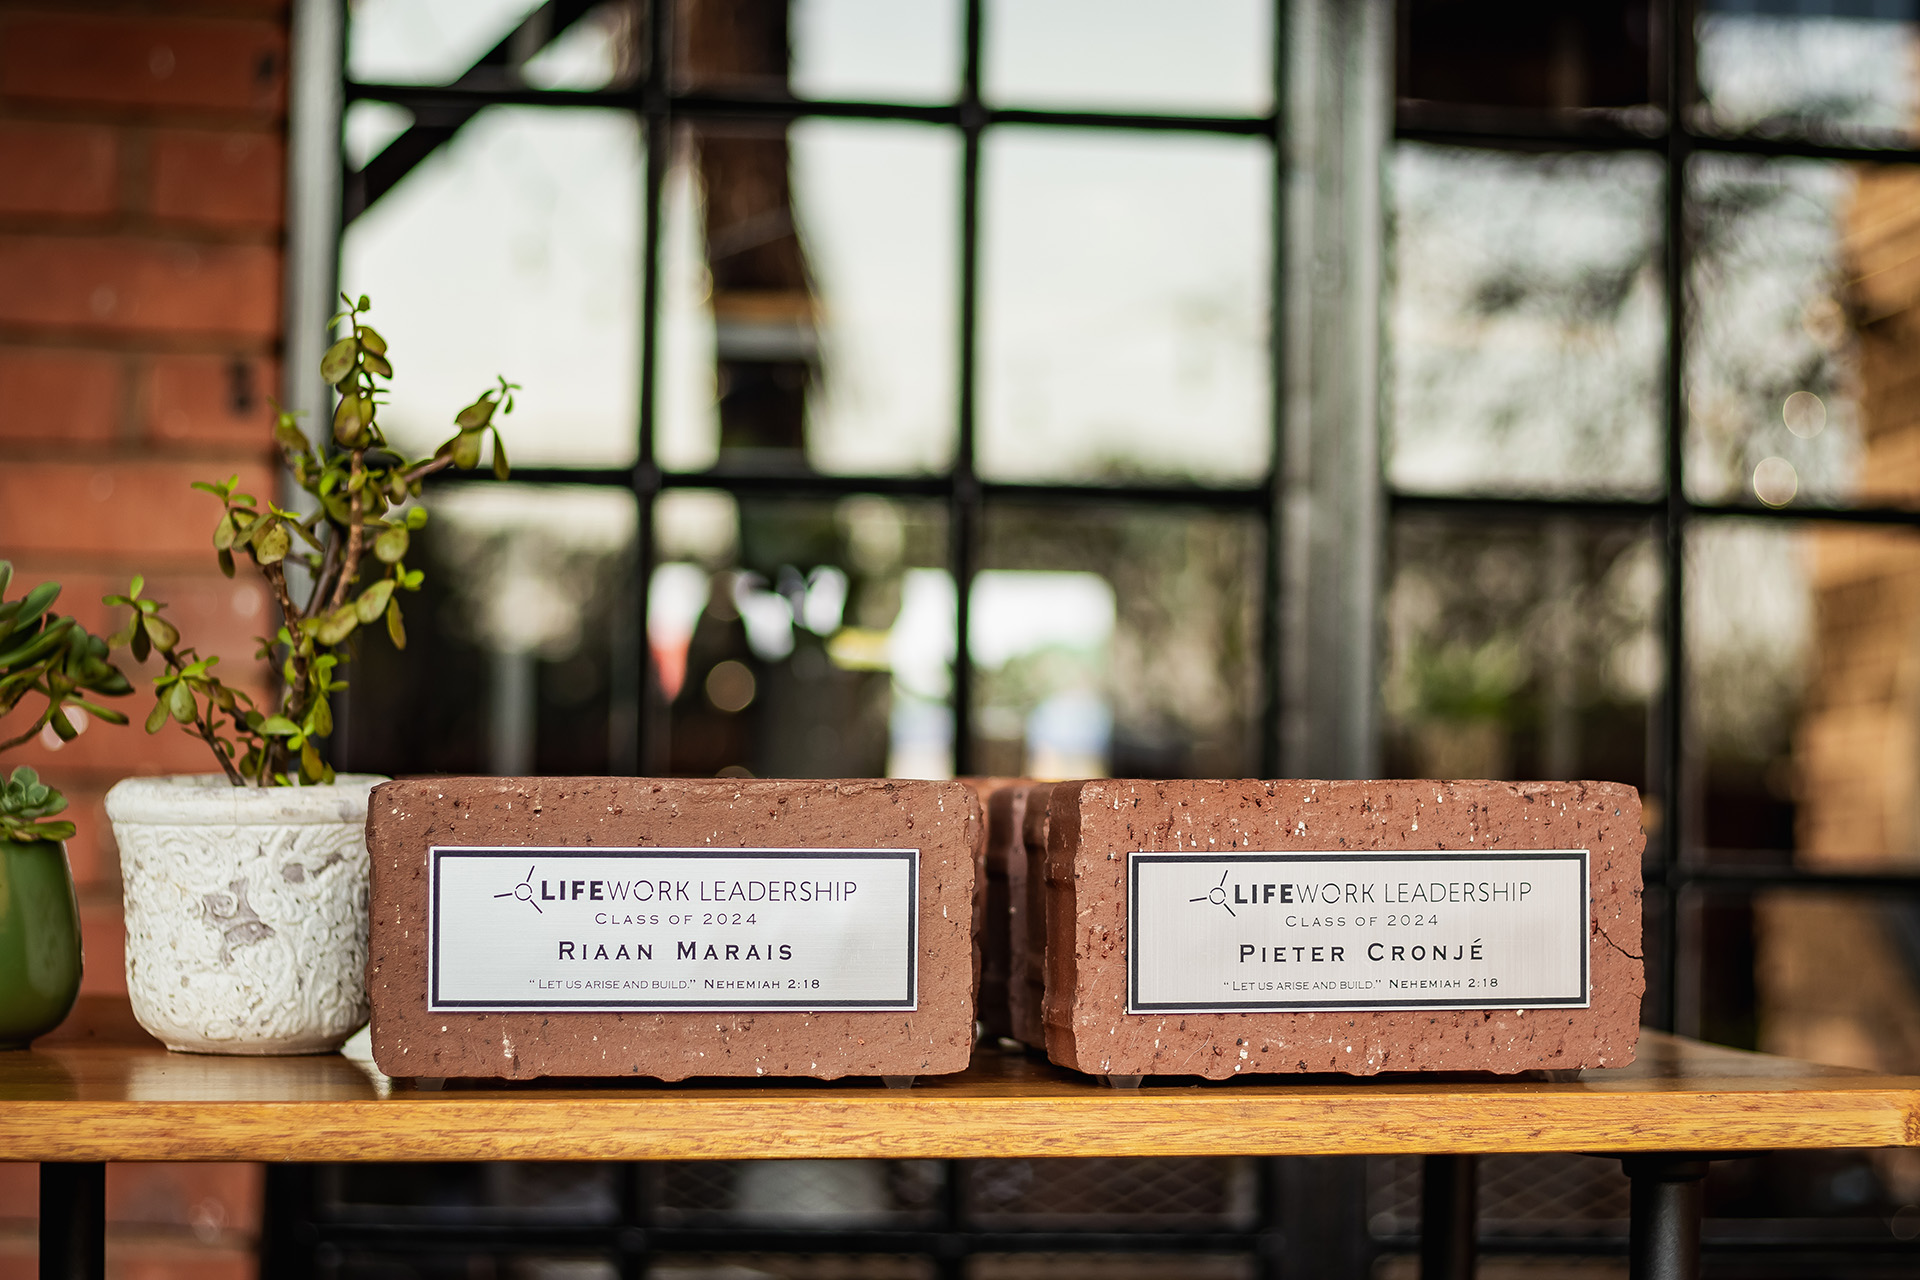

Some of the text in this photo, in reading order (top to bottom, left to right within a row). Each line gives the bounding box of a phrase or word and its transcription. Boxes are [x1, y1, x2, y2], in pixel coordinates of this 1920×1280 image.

[541, 880, 858, 902] LIFEWORK LEADERSHIP
[1234, 882, 1532, 904] LIFEWORK LEADERSHIP
[702, 912, 757, 925] 2024
[1386, 914, 1438, 927] 2024
[787, 978, 821, 990] 2:18
[1467, 977, 1500, 989] 2:18
